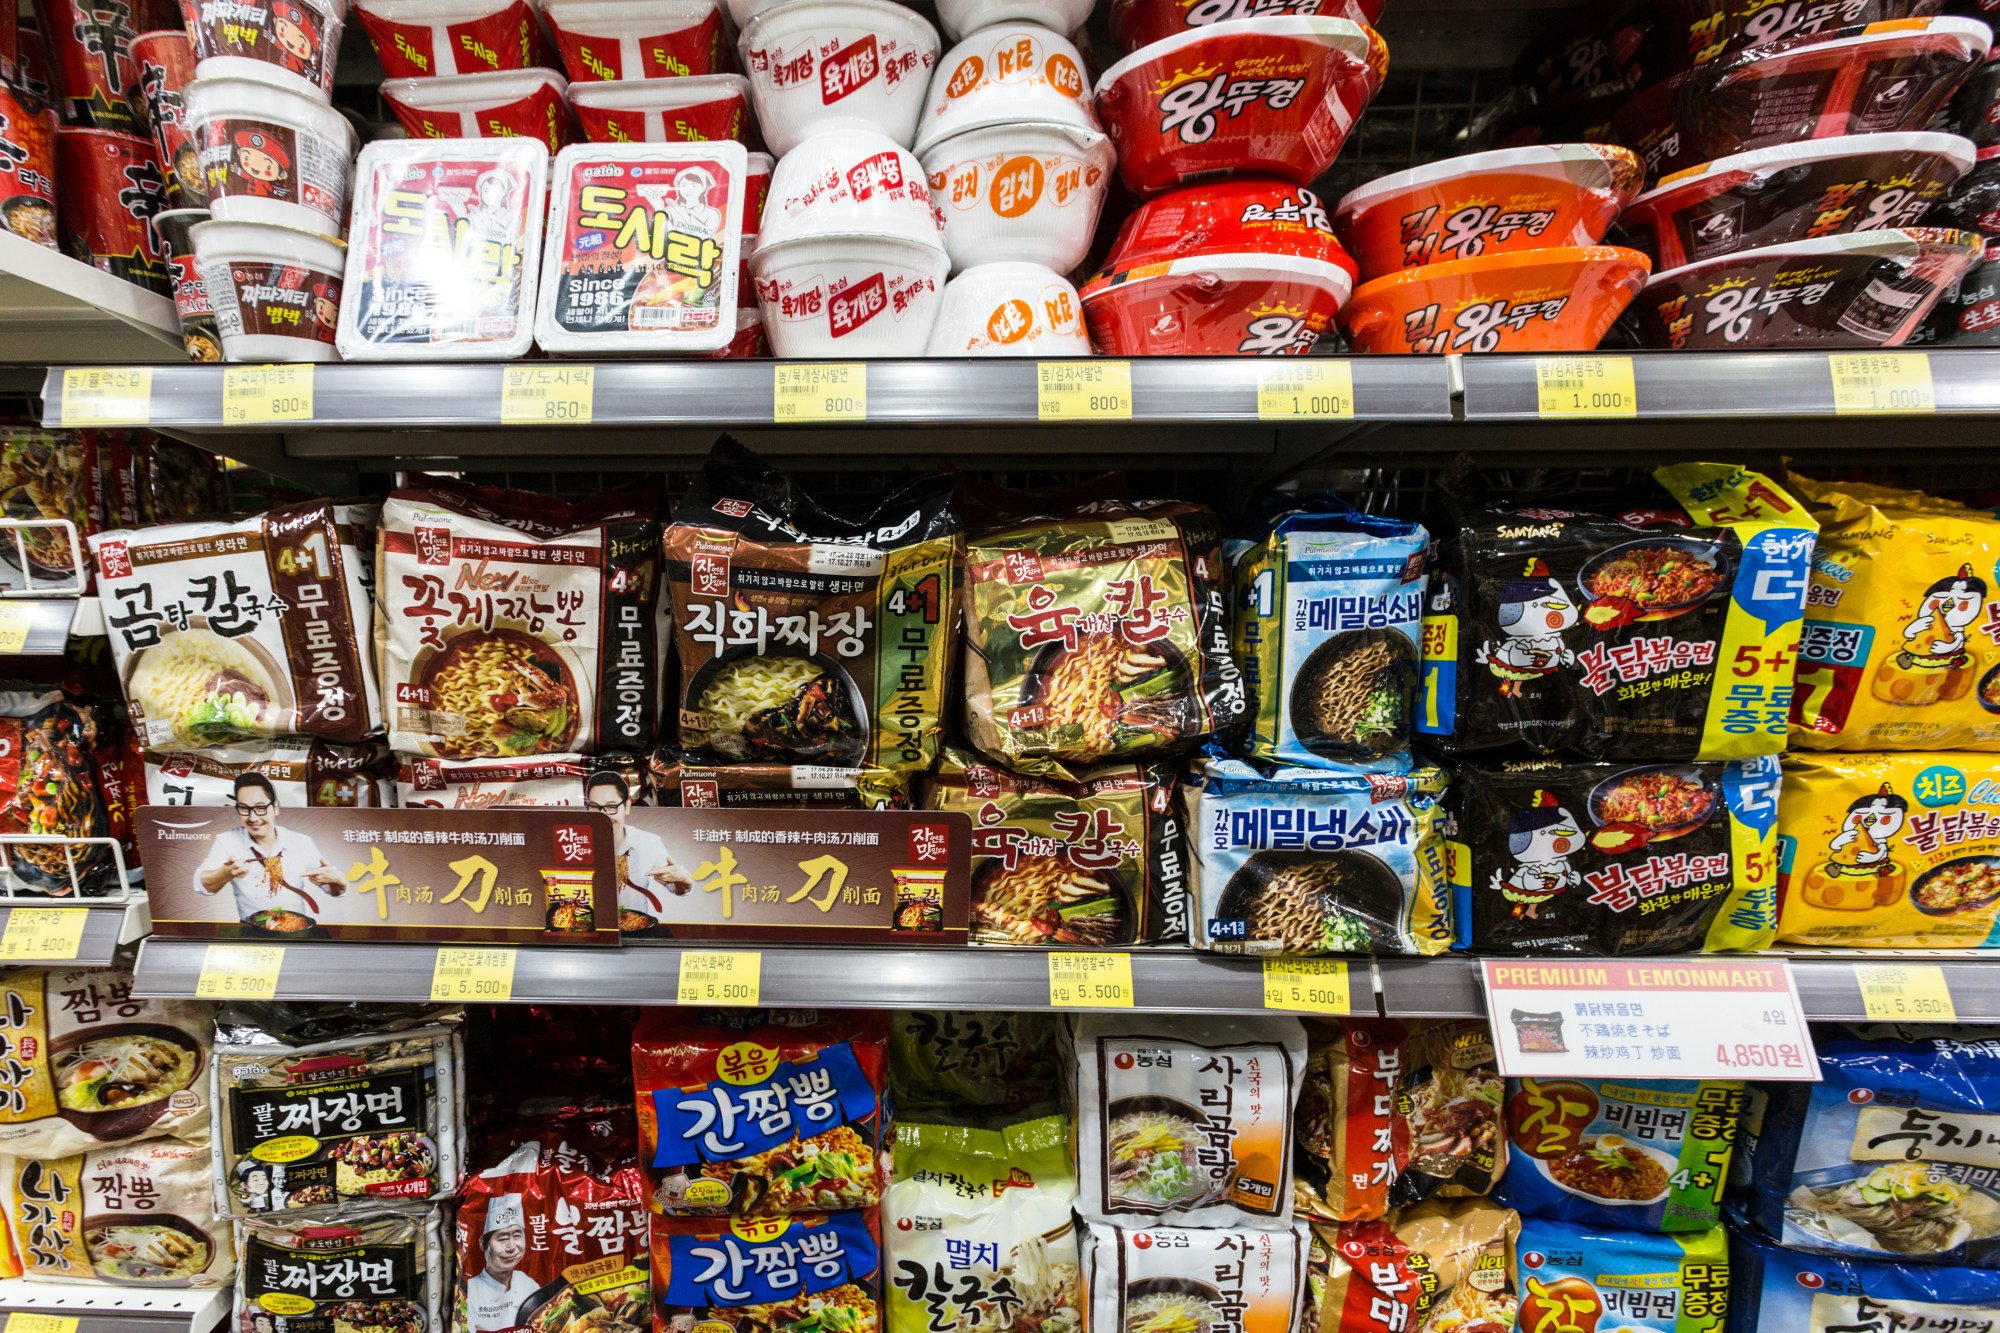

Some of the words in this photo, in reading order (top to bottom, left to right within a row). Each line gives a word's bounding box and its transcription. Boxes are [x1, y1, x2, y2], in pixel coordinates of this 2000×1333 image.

[223, 25, 259, 46] 범벅
[394, 33, 429, 72] 도시락
[461, 34, 498, 69] 도시락
[820, 38, 841, 56] 농심
[881, 38, 897, 55] 농심
[772, 49, 815, 86] 육개장
[822, 42, 879, 98] 육개장
[1159, 74, 1306, 144] 왕뚜껑
[583, 164, 623, 180] paldo
[985, 154, 1006, 170] 농심
[1043, 155, 1062, 169] 농심
[952, 164, 980, 204] 김치
[999, 163, 1037, 210] 김치
[1055, 167, 1082, 200] 김치
[578, 184, 723, 289] 도시락
[578, 233, 603, 248] 元祖
[1401, 205, 1440, 267] 김치
[1439, 206, 1555, 259] 왕뚜껑
[569, 277, 626, 294] Since
[828, 275, 849, 294] 농심
[241, 283, 309, 308] 짜파게티
[568, 292, 625, 307] 1986
[780, 287, 823, 318] 육개장
[266, 305, 301, 326] 범벅
[831, 286, 886, 331] 육개장
[1704, 280, 1835, 343] 왕뚜껑
[1453, 297, 1569, 353] 왕뚜껑
[1657, 295, 1692, 349] 짬뽕
[508, 369, 590, 387] 팔/도시락
[777, 366, 849, 385] 농/육개장사발면
[1040, 365, 1104, 384] 농/김치사발면
[1540, 360, 1605, 380] 팔/김치왕뚜껑
[226, 405, 248, 420] 70g
[411, 512, 453, 524] Pulmuone
[418, 529, 448, 547] 자연은
[1496, 522, 1565, 539] SAMYANG
[1836, 526, 1900, 541] SAMYANG
[214, 537, 248, 551] 생라면
[422, 544, 450, 563] 맛있다
[459, 543, 481, 555] 튀기지
[483, 545, 498, 556] 않고
[499, 546, 530, 558] 바람으로
[531, 549, 546, 560] 말린
[550, 549, 585, 564] 생라면
[694, 541, 733, 552] Pulmuone
[1088, 549, 1116, 562] 바람으로
[1136, 542, 1168, 556] 생라면
[1305, 546, 1340, 554] Pulmuone
[278, 532, 332, 578] 4+1
[1007, 552, 1036, 567] 자연은
[455, 557, 520, 593] New
[696, 556, 725, 575] 자연은
[1016, 565, 1041, 583] 맛있다
[1308, 566, 1332, 575] 튀기지
[1334, 566, 1349, 575] 않고
[1352, 564, 1384, 574] 바람으로
[700, 572, 727, 592] 맛있다
[737, 573, 760, 585] 튀기지
[761, 575, 777, 587] 않고
[777, 576, 808, 588] 바람으로
[809, 578, 825, 591] 말린
[828, 579, 865, 593] 생라면
[1751, 570, 1807, 609] 더
[887, 574, 941, 624] 4+1
[108, 569, 290, 652] 곰탕칼국수
[402, 573, 586, 650] 꽃게짬뽕
[1007, 575, 1188, 652] 육개장칼국수
[1294, 599, 1308, 631] 가쓰오
[1308, 591, 1425, 631] 메밀냉소바
[683, 600, 873, 659] 직화짜장
[296, 583, 346, 722] 무료증정
[616, 606, 645, 737] 무료증정
[1578, 640, 1717, 695] 불닭볶음면
[897, 626, 930, 763] 무료증정
[1617, 681, 1662, 700] 화끈한
[1663, 673, 1712, 690] 매운맛!
[533, 765, 567, 777] 생라면
[1502, 760, 1562, 772] SAMYANG
[1839, 755, 1893, 767] SAMYANG
[259, 765, 291, 778] 생라면
[678, 769, 717, 779] Pulmuone
[685, 784, 715, 799] 자연은
[1092, 777, 1125, 791] 생라면
[1917, 776, 1963, 800] 치즈
[812, 790, 846, 800] 생라면
[157, 829, 212, 842] Pulmuone
[342, 829, 381, 844] 非油炸
[384, 830, 526, 846] 制成的香辣牛肉汤刀削面
[556, 828, 588, 845] 자연은
[692, 828, 732, 842] 非油炸
[735, 830, 880, 846] 制成的香辣牛肉汤刀削面
[912, 828, 945, 844] 자연은
[1214, 808, 1230, 850] 가쓰오
[1231, 805, 1411, 850] 메밀냉소바
[562, 843, 592, 862] 맛있다
[916, 842, 947, 861] 맛있다
[346, 846, 533, 920] 牛肉汤刀削面
[693, 846, 881, 919] 牛肉汤刀削面
[1583, 853, 1728, 912] 불닭볶음면
[1683, 882, 1731, 902] 매운맛!
[199, 980, 217, 992] 5입
[1495, 967, 1608, 987] PREMIUM
[1627, 967, 1775, 988] LEMONMART
[433, 983, 450, 996] 4입
[680, 988, 699, 1001] 5입
[1052, 988, 1070, 1001] 4입
[1265, 990, 1283, 1004] 4입
[1762, 1009, 1786, 1026] 4입
[1869, 1002, 1890, 1014] 4+1
[1579, 1023, 1671, 1038] 不鶏焼きそば
[649, 1045, 700, 1059] SAMYANG
[1136, 1053, 1173, 1068] 농심
[1584, 1044, 1643, 1060] 辣炒鸡丁
[1650, 1044, 1682, 1060] 炒面
[1717, 1043, 1803, 1067] 4,850원
[233, 1065, 269, 1078] paldo
[721, 1049, 768, 1079] 볶음
[277, 1086, 406, 1135] 짜장면
[675, 1068, 838, 1155] 간짬뽕
[1604, 1104, 1687, 1141] 비빔면
[149, 1148, 196, 1160] SAMYANG
[1352, 1173, 1368, 1189] 면
[1668, 1145, 1732, 1205] 4+1
[93, 1172, 162, 1211] 짬뽕
[403, 1180, 427, 1195] 4개입
[1238, 1177, 1272, 1197] 5개입
[529, 1213, 550, 1252] 팔도
[914, 1219, 942, 1231] 농심
[1154, 1232, 1189, 1249] 농심
[946, 1237, 1000, 1273] 멸치
[1475, 1256, 1504, 1270] New
[1545, 1256, 1583, 1267] 농심
[689, 1230, 845, 1301] 간짬뽕
[280, 1259, 397, 1298] 짜장면
[893, 1259, 1024, 1333] 칼국수
[1602, 1291, 1677, 1320] 비빔면
